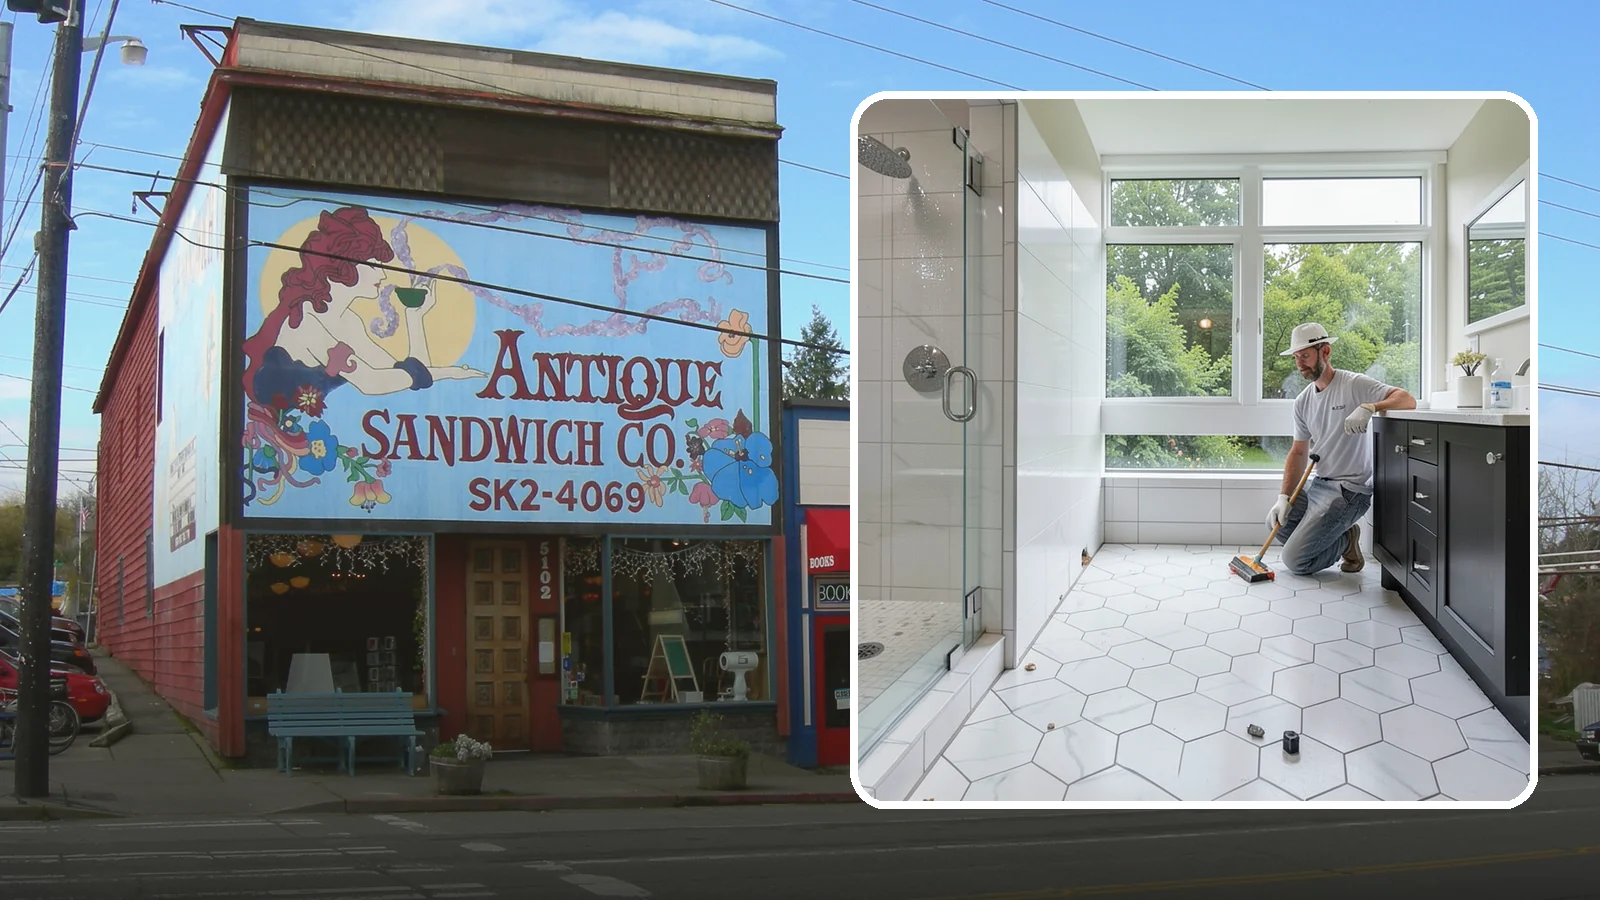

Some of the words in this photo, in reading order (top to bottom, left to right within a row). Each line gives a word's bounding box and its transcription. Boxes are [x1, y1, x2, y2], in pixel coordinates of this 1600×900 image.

[476, 329, 723, 420] ANTIQUE
[361, 409, 604, 467] SANDWICH
[617, 421, 684, 467] CO.
[468, 477, 646, 513] SK2-4069
[540, 541, 552, 599] 5102
[809, 555, 835, 568] BOOKS
